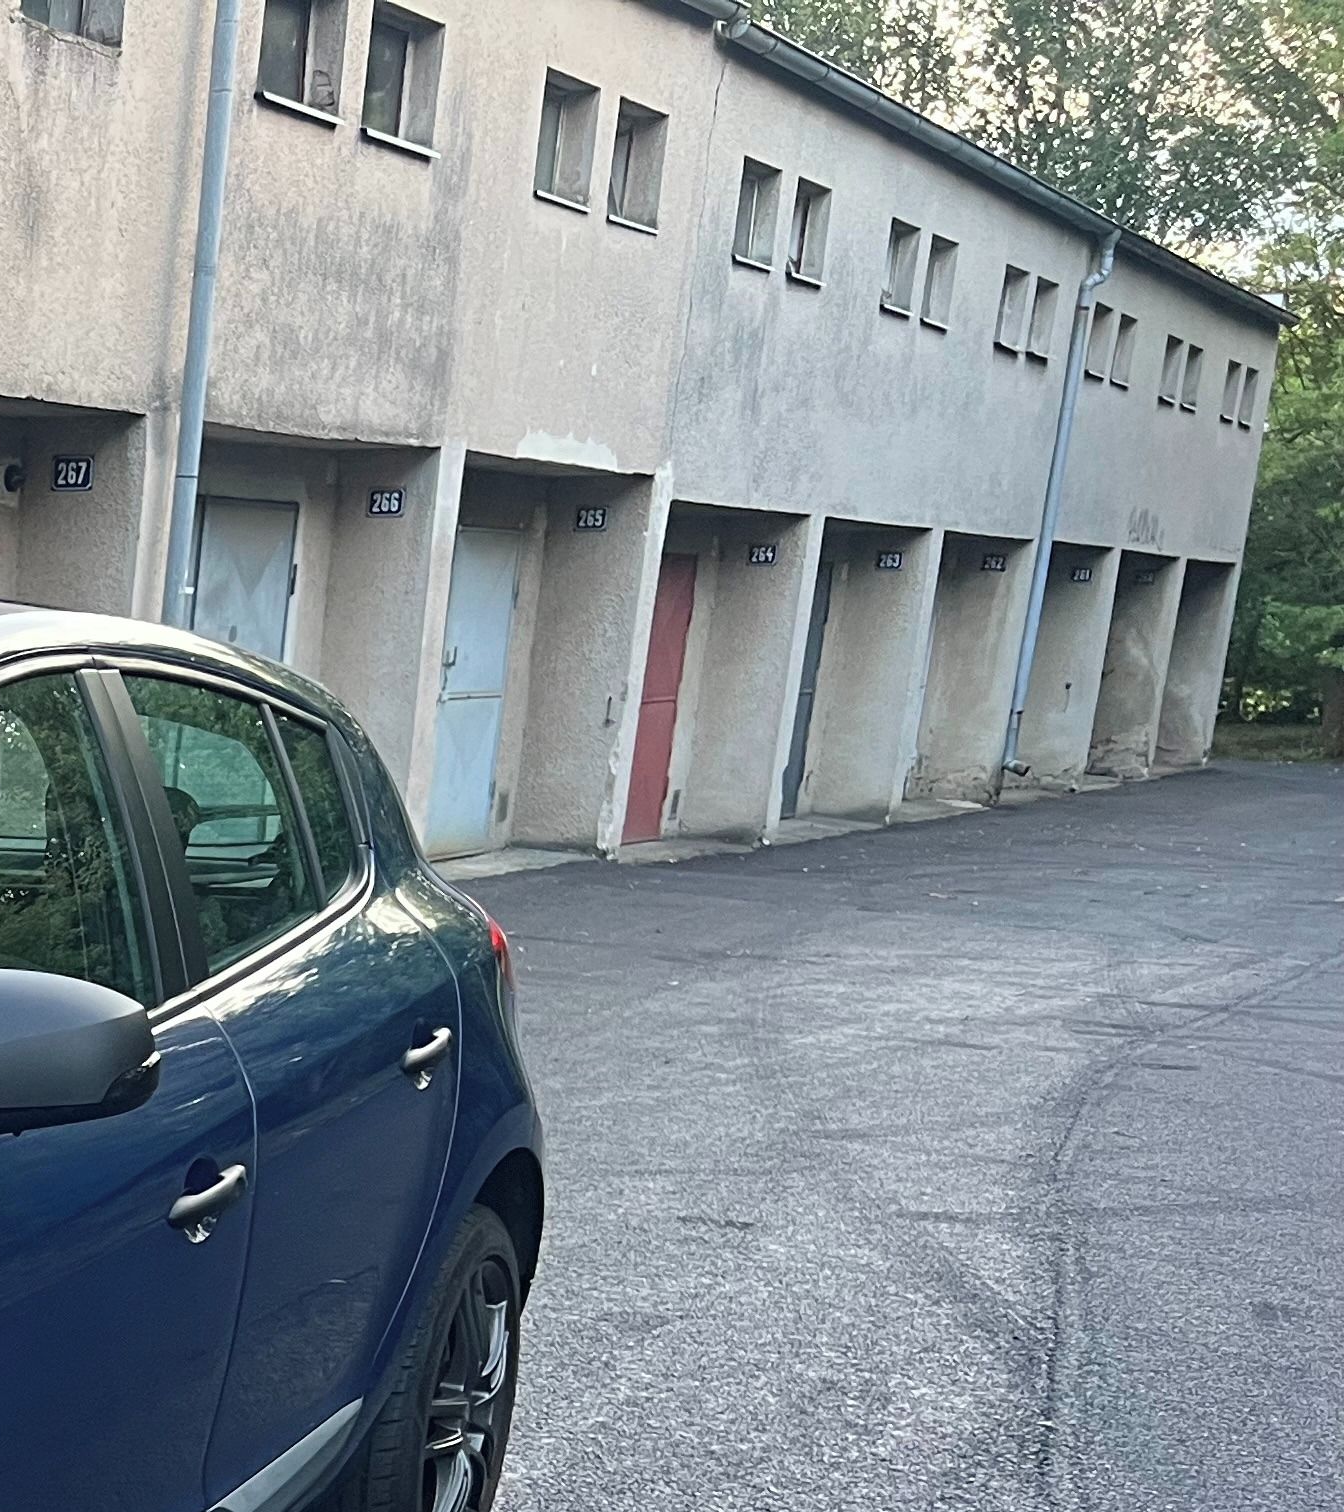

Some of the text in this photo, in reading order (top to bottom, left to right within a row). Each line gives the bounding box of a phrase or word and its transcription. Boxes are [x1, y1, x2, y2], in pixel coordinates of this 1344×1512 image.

[57, 462, 87, 485] 267
[372, 492, 399, 512] 266
[578, 509, 603, 526] 265
[751, 546, 774, 562] 264
[880, 553, 900, 568] 263
